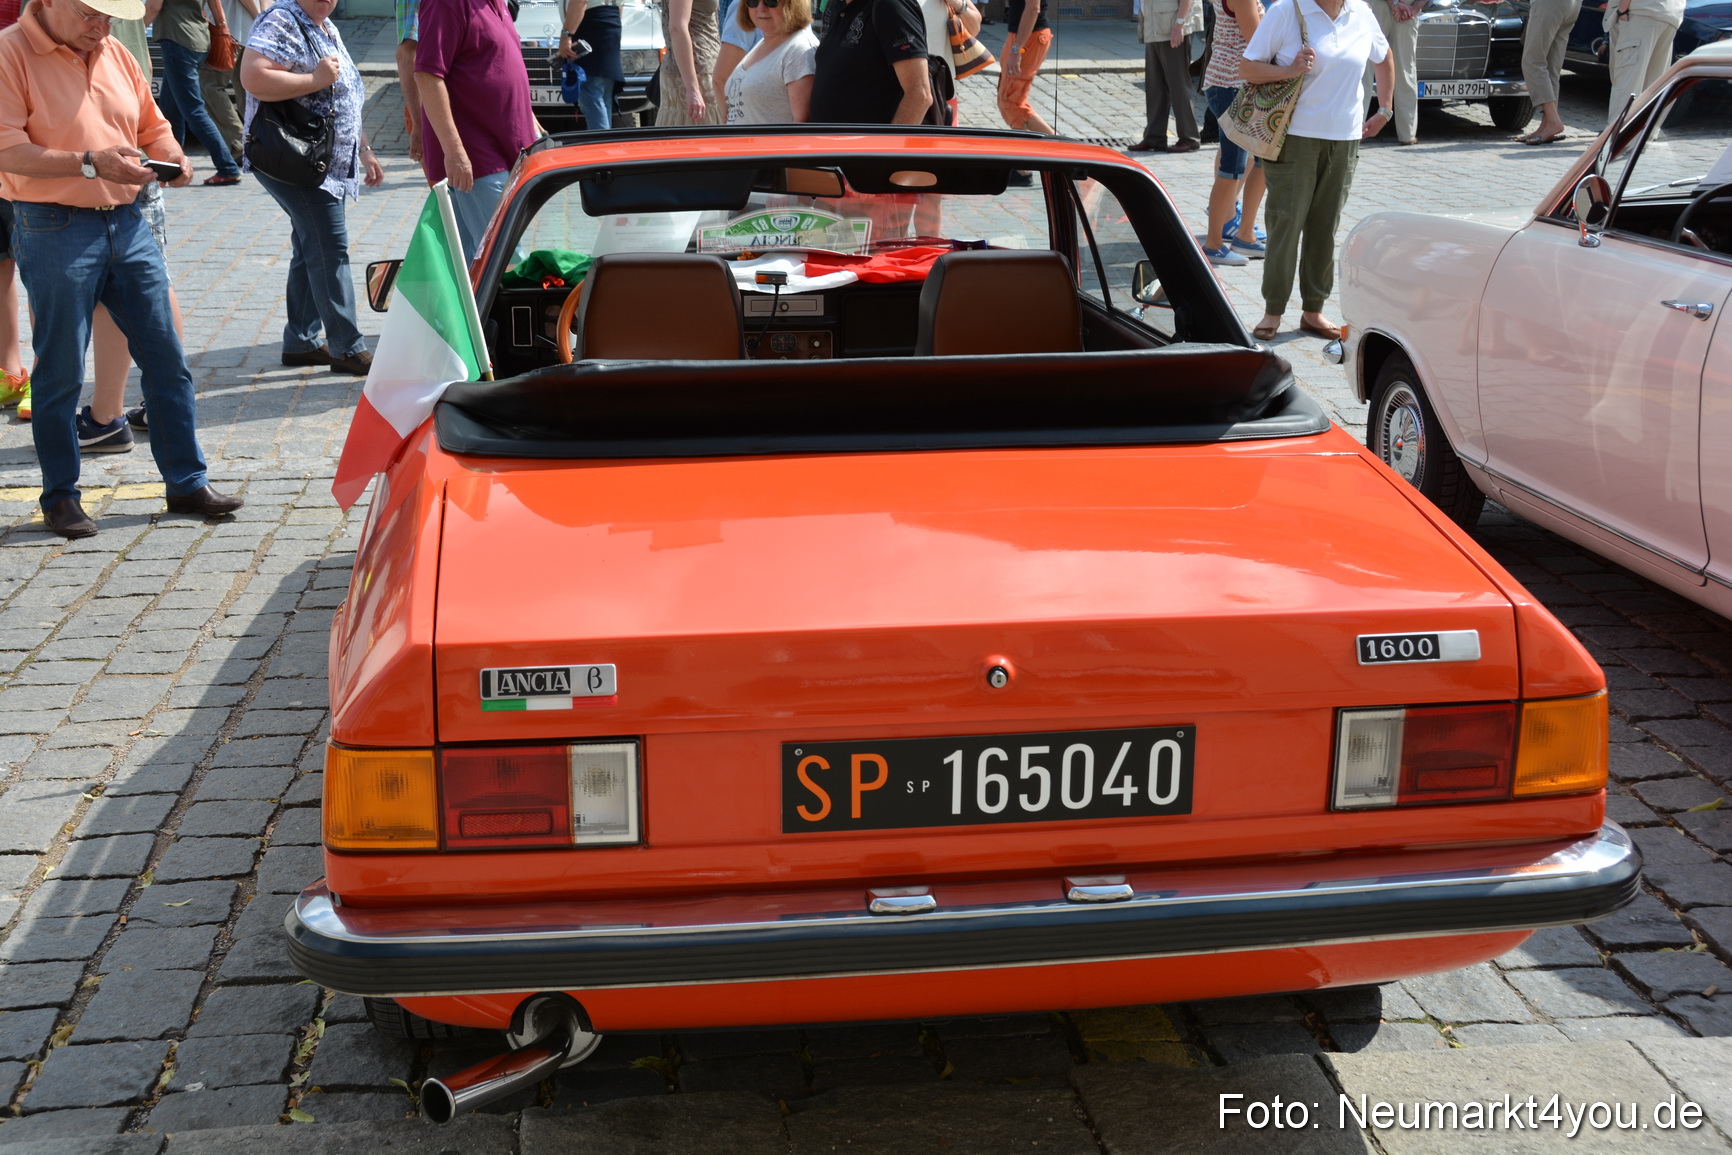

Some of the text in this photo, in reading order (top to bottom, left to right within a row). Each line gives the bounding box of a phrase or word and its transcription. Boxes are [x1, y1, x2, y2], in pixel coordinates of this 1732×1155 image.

[546, 90, 562, 102] T7
[1424, 83, 1486, 96] N AM 879H
[1366, 637, 1433, 659] 1600
[490, 669, 571, 697] LANCIA
[943, 739, 1182, 815] 165040
